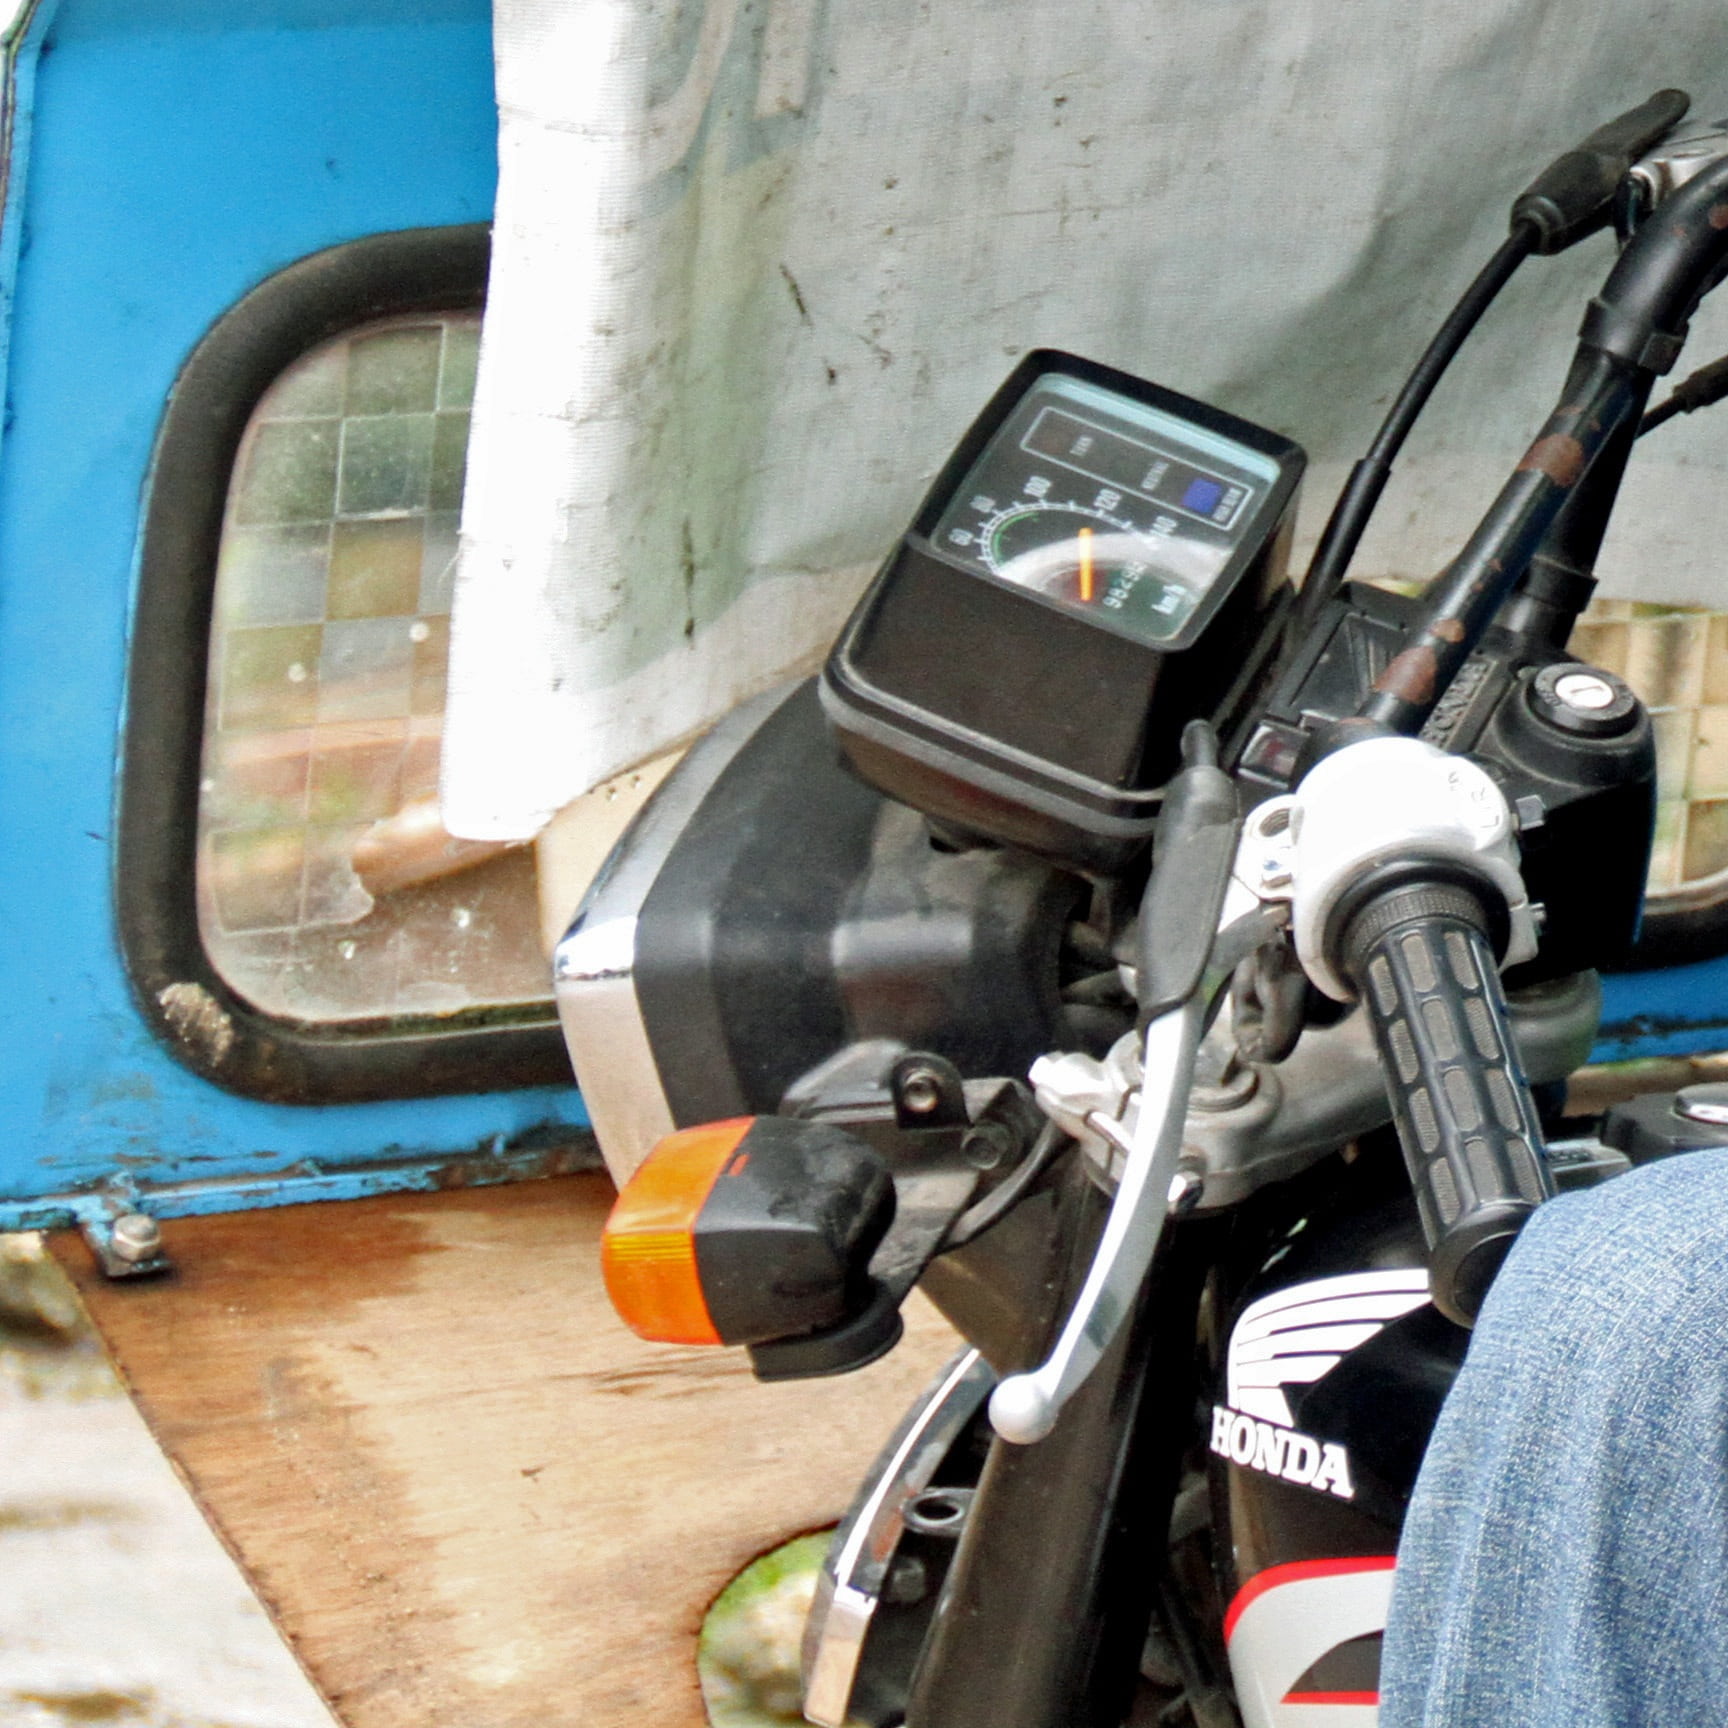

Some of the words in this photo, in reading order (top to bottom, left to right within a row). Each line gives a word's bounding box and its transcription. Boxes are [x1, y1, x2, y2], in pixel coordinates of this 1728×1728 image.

[1022, 475, 1054, 499] 100
[1093, 488, 1123, 513] 120
[1209, 1406, 1355, 1501] HONDA
